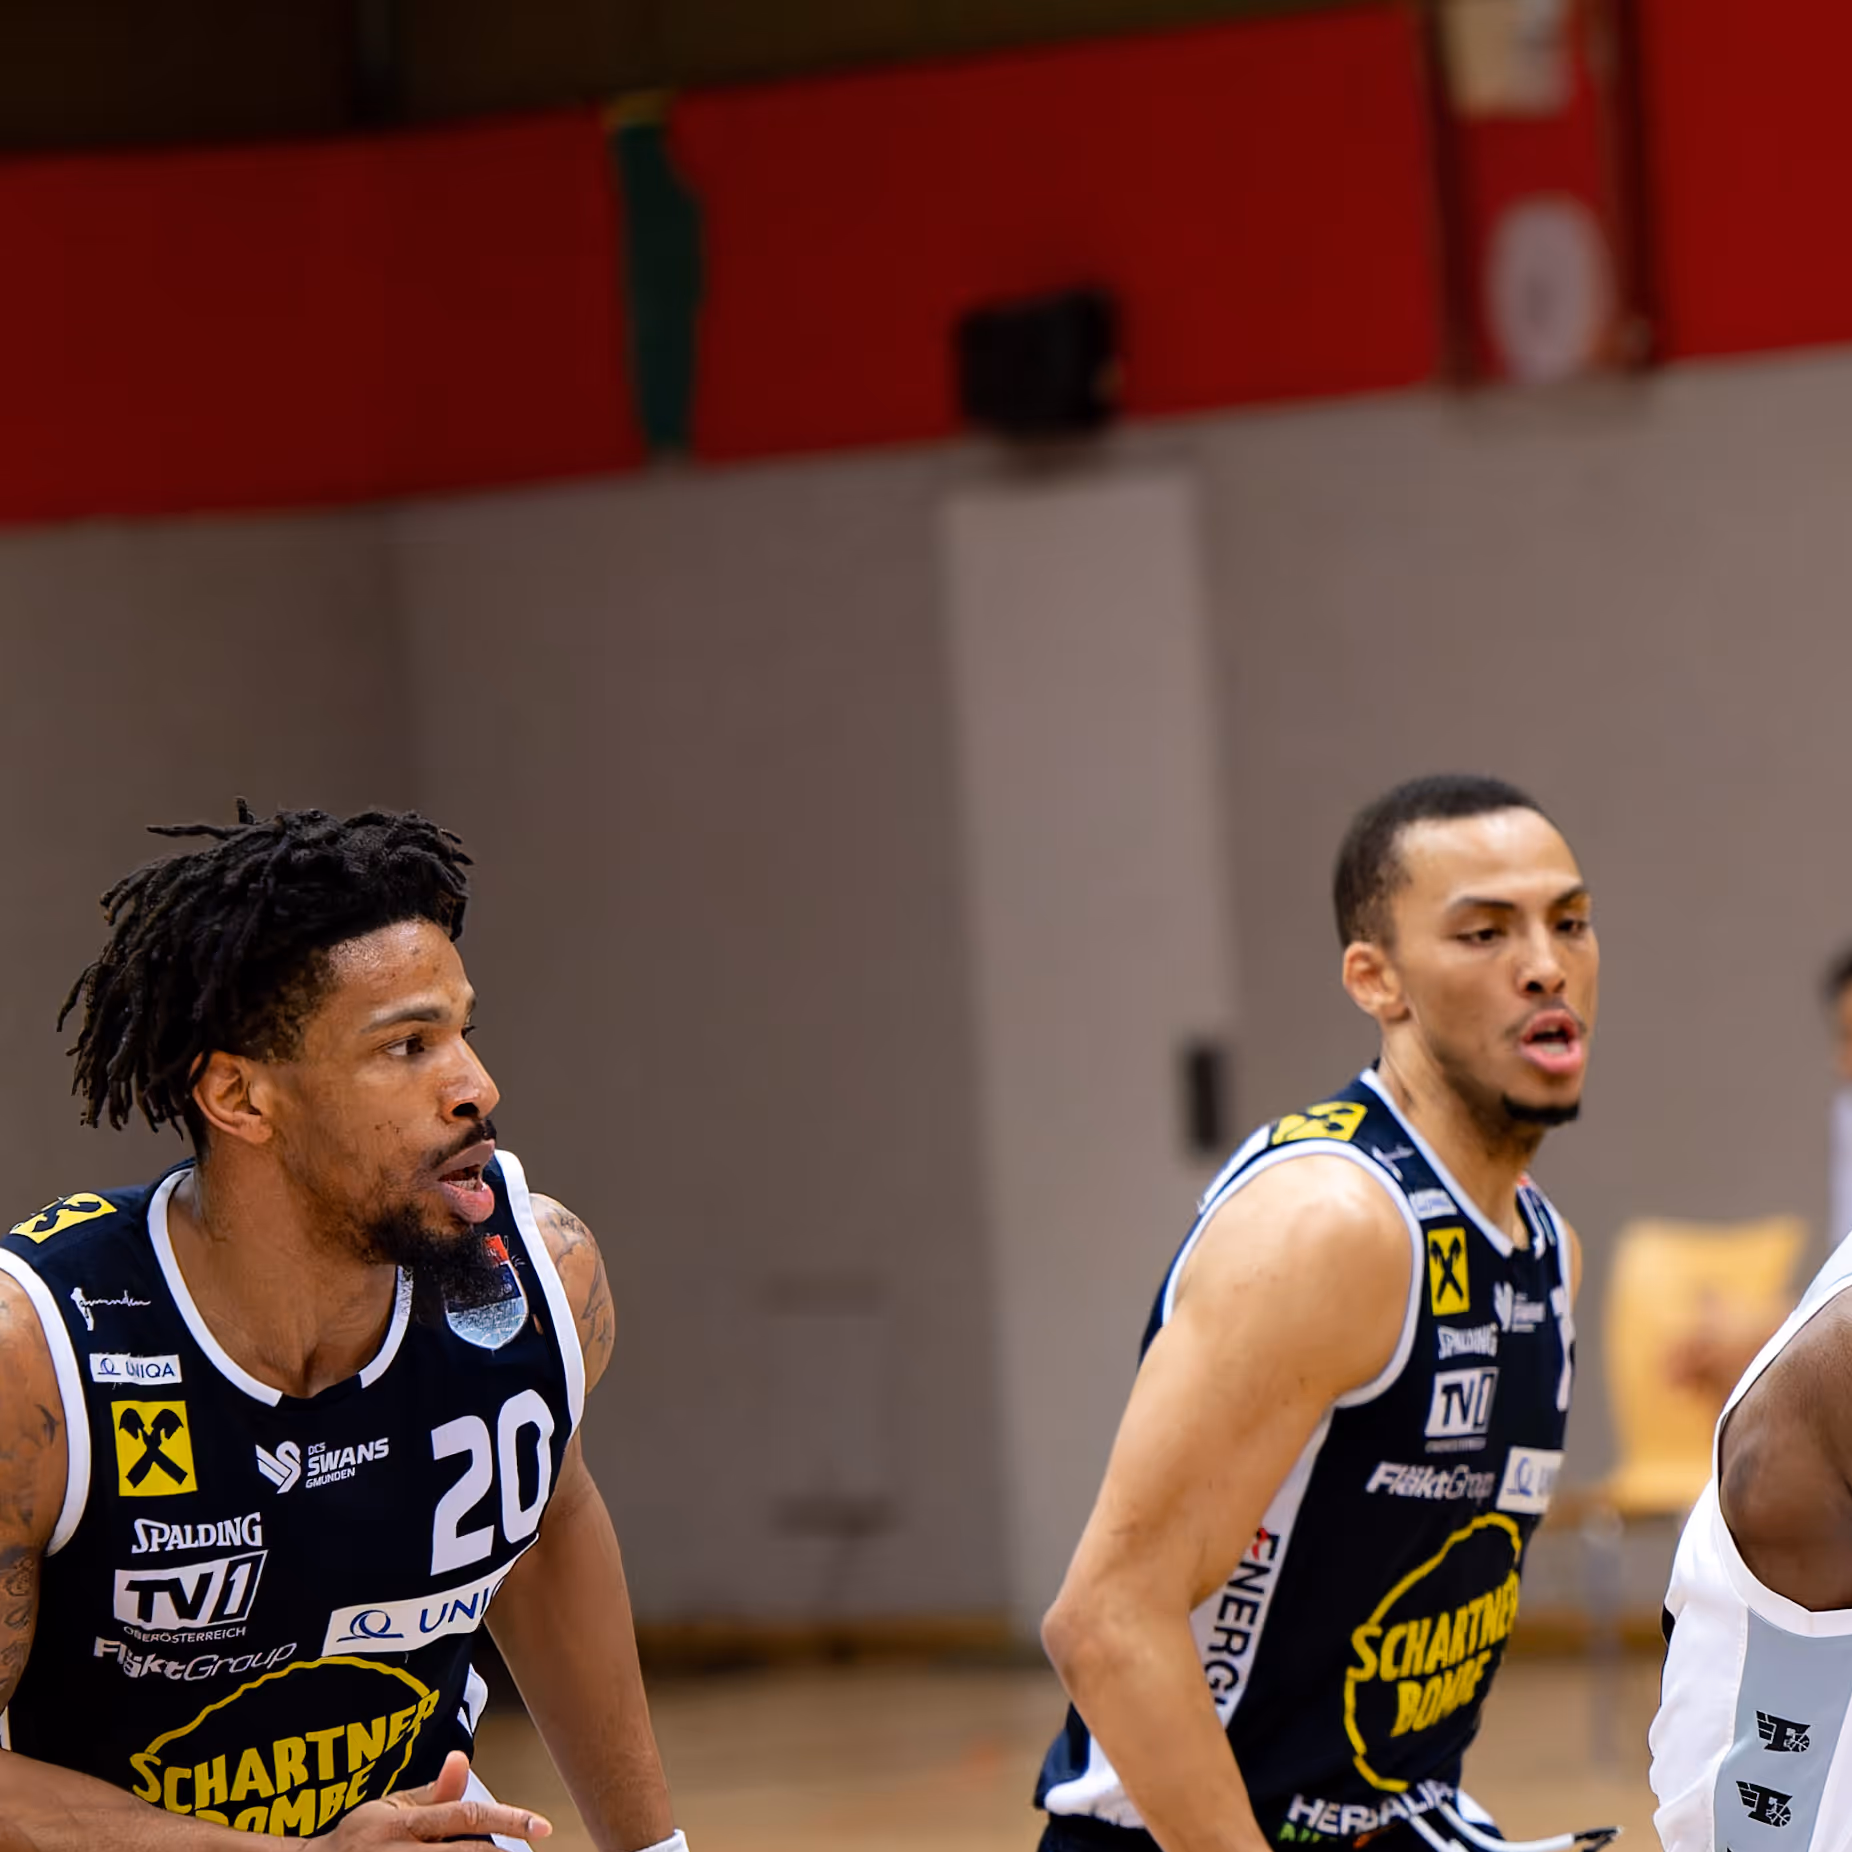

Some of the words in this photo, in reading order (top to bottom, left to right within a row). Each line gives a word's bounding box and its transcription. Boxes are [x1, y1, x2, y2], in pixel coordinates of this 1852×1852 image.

[1437, 1322, 1499, 1360] SPALDING
[307, 1442, 326, 1456] DCS
[307, 1437, 390, 1477] SWANS
[305, 1467, 356, 1489] GMUNDEN
[430, 1388, 555, 1577] 20
[131, 1511, 263, 1554] SPALDING
[124, 1562, 253, 1624] TV1
[418, 1586, 490, 1634] UNI
[1350, 1569, 1520, 1682] SCHARTNER
[129, 1689, 440, 1815] SCHARTNER
